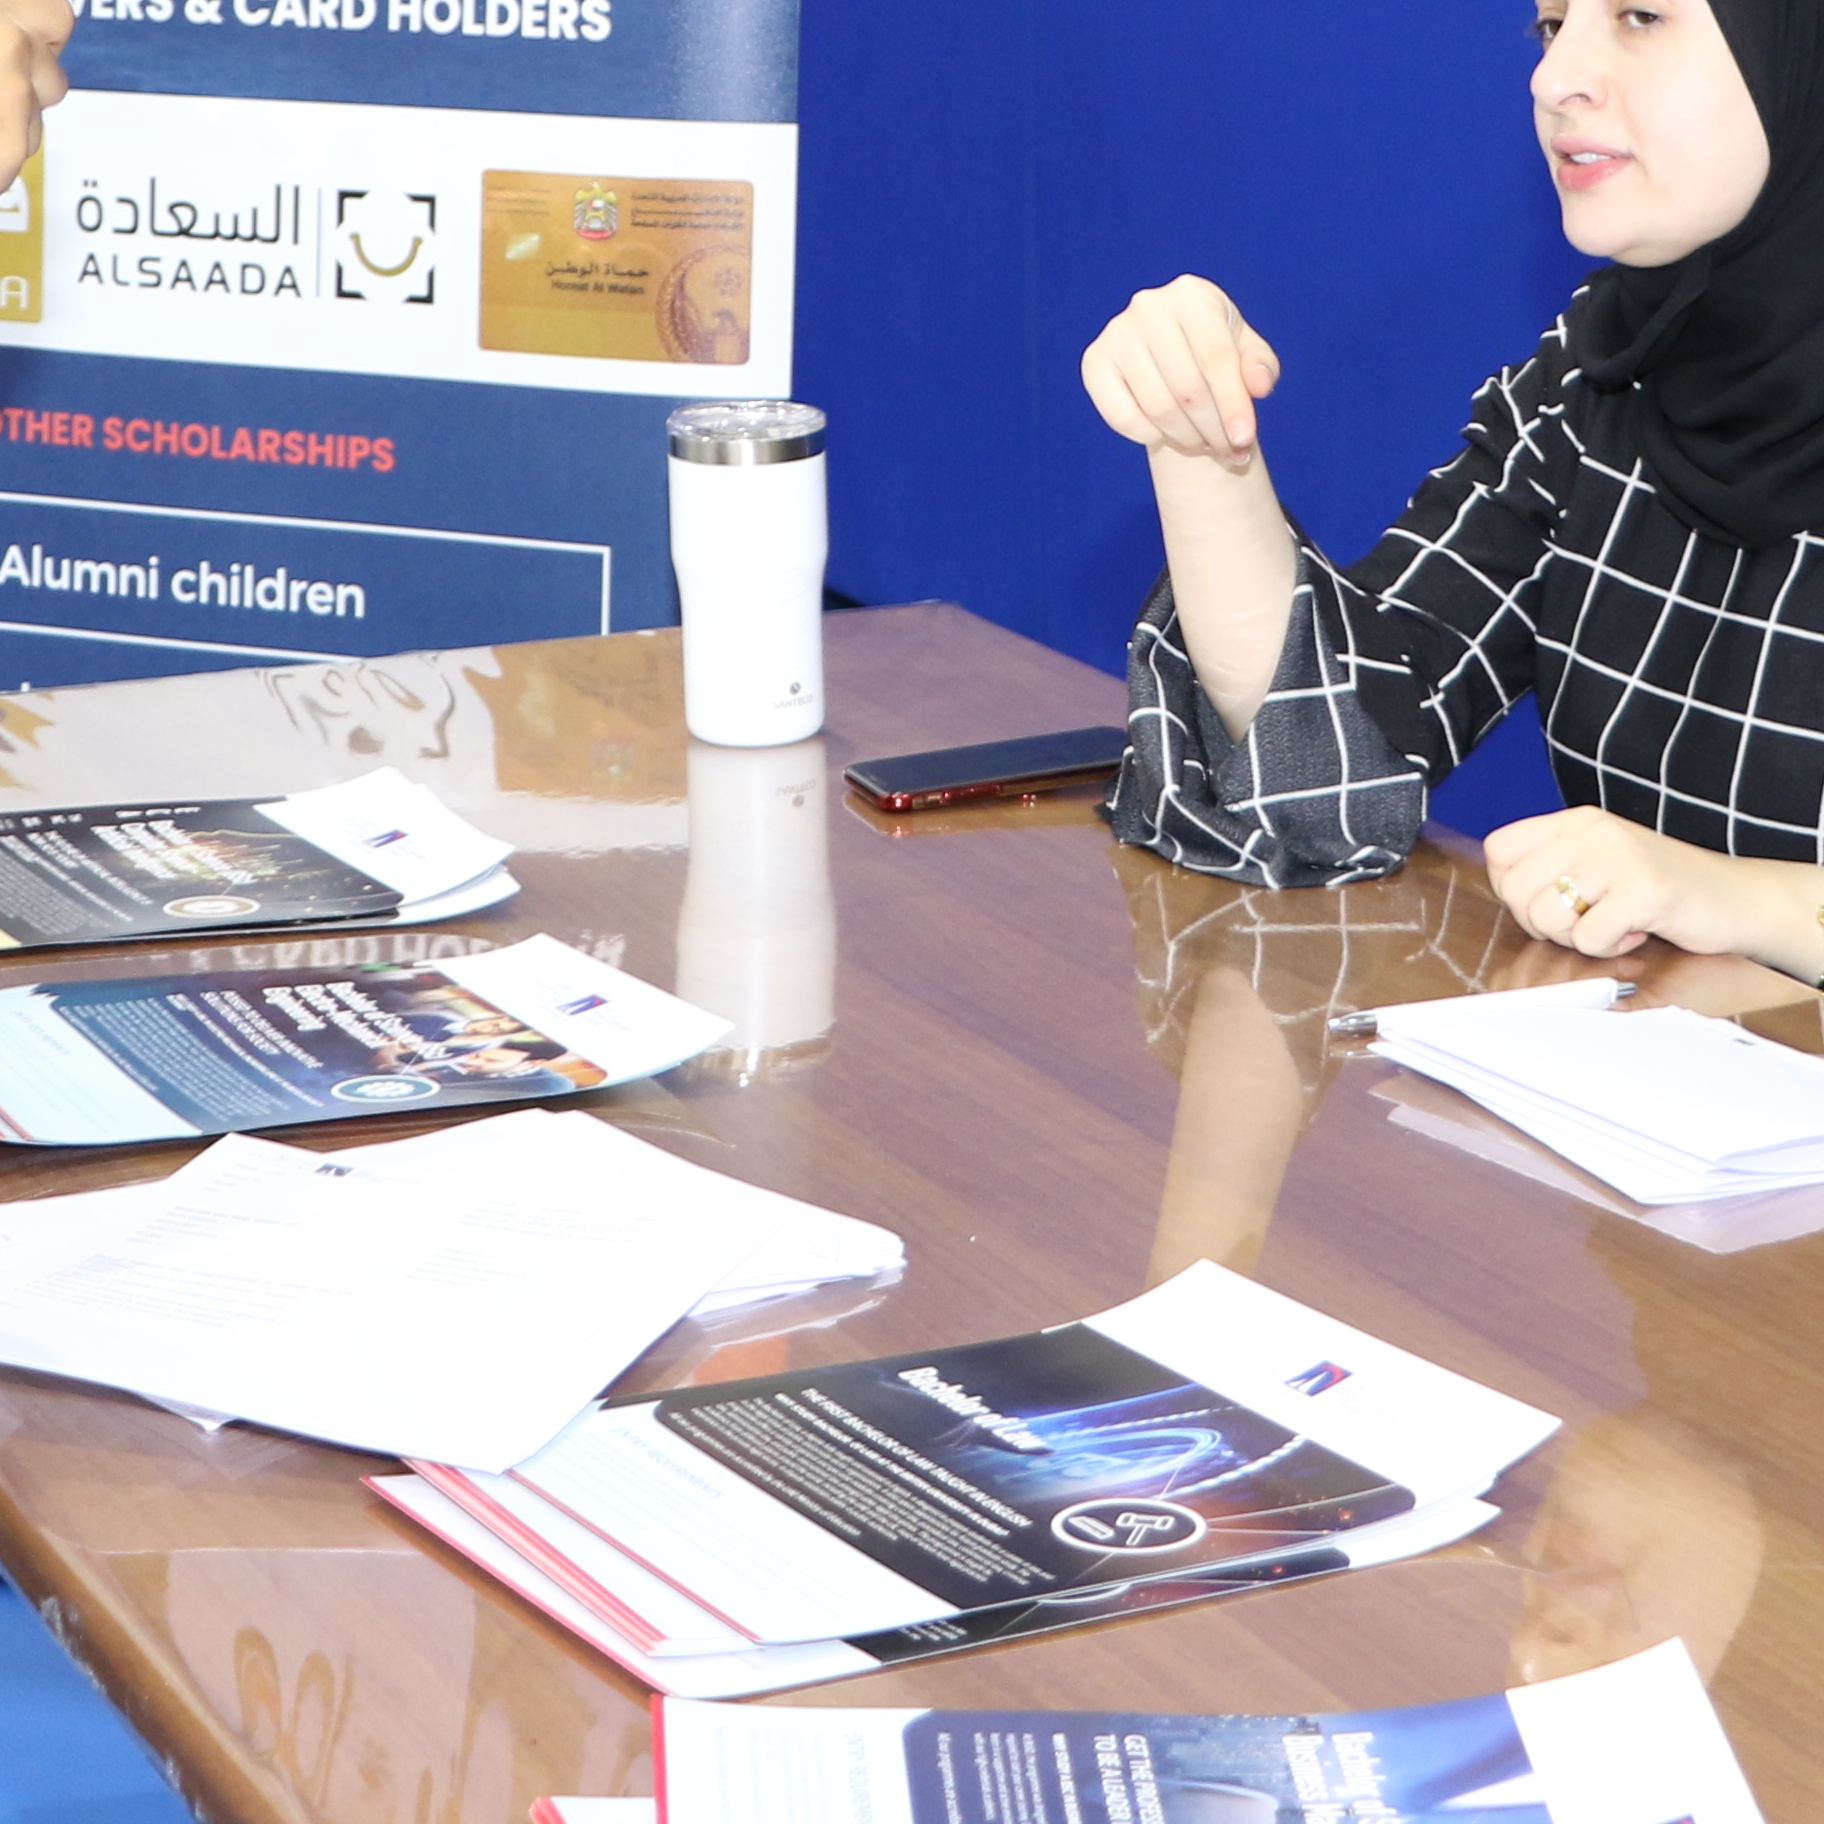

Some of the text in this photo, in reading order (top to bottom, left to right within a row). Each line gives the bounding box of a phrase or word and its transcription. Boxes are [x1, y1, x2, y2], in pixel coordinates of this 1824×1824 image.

[77, 176, 300, 246] السعادة
[77, 252, 303, 298] ALSAADA
[102, 416, 396, 472] SCHOLARSHIPS
[170, 560, 366, 618] children
[799, 1387, 827, 1404] THE
[898, 1366, 1048, 1450] Bachelor of Law
[1094, 1734, 1118, 1753] TO
[1097, 1751, 1121, 1768] BE
[1124, 1733, 1149, 1759] GET
[1282, 1734, 1332, 1800] Business
[1331, 1731, 1387, 1797] Bachelor
[1129, 1759, 1154, 1781] THE
